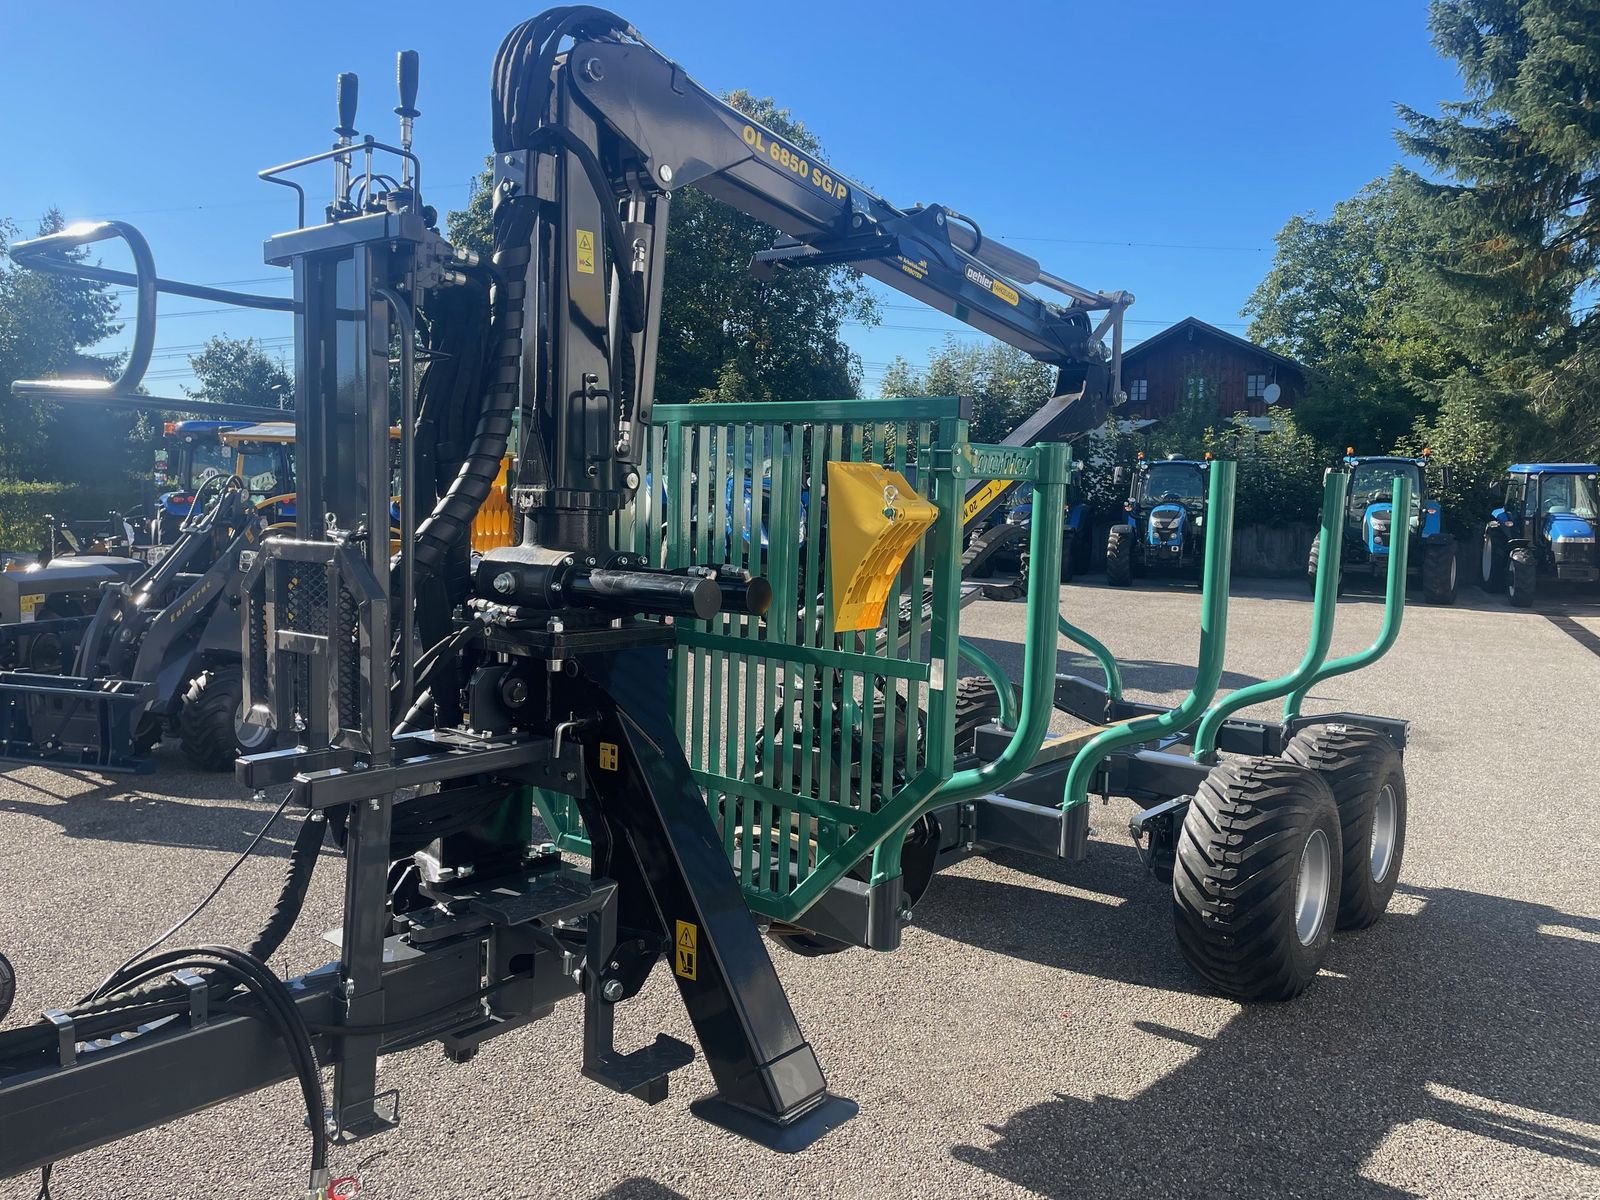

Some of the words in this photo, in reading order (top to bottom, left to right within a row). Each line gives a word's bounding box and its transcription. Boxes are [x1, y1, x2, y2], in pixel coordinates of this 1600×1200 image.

[743, 125, 765, 152] OL
[769, 142, 808, 178] 6850
[812, 168, 847, 200] SG/P
[967, 268, 993, 289] oehler
[969, 500, 978, 513] 20
